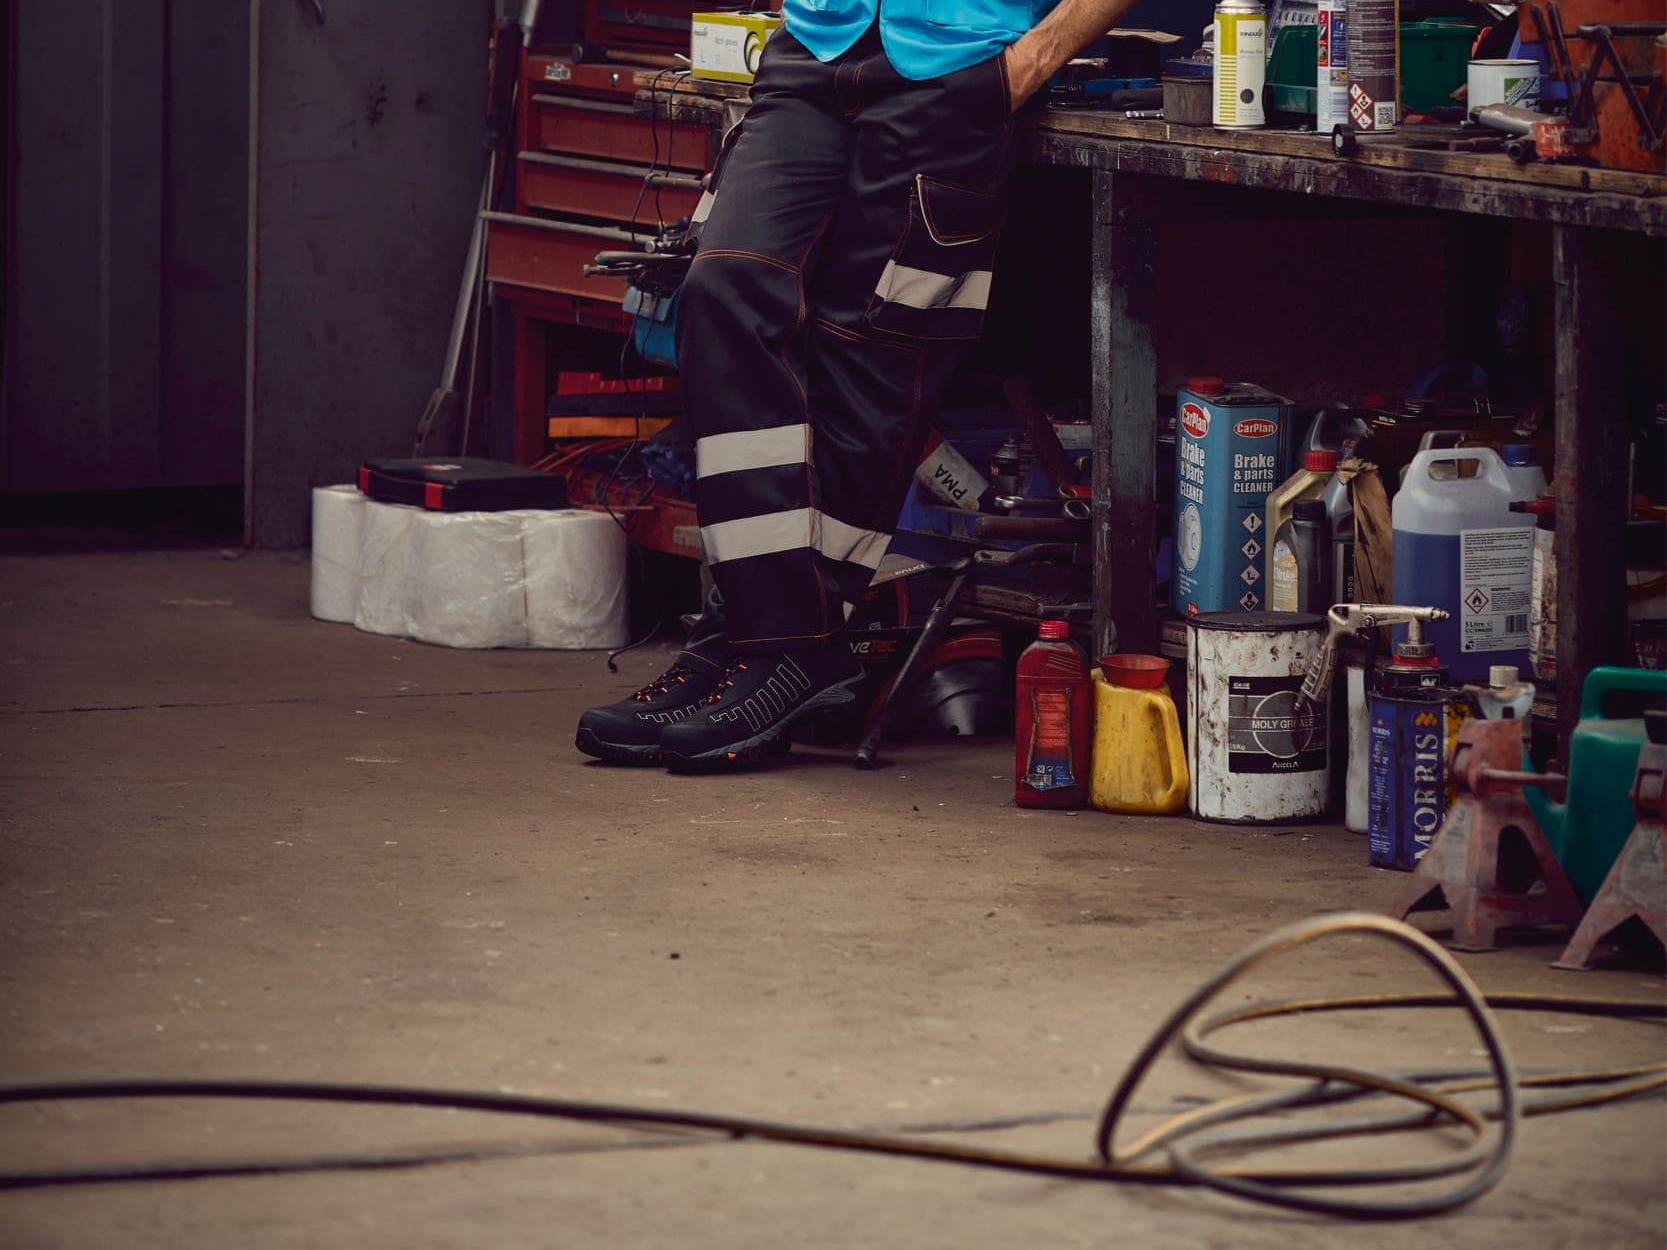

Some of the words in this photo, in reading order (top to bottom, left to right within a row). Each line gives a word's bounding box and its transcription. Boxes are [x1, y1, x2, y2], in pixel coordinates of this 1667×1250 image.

[1181, 407, 1207, 433] CarPlan
[1236, 422, 1274, 433] CarPlan
[1181, 436, 1205, 467] Brake
[1234, 453, 1275, 469] Brake
[934, 463, 968, 500] PMA
[1186, 466, 1204, 485] parts
[1233, 470, 1241, 480] &
[1244, 468, 1274, 481] parts
[1180, 479, 1204, 505] CLEANER
[1233, 482, 1273, 493] CLEANER
[1251, 719, 1278, 729] MOLY
[1279, 718, 1314, 728] GREASE
[1414, 733, 1439, 862] MORRIS
